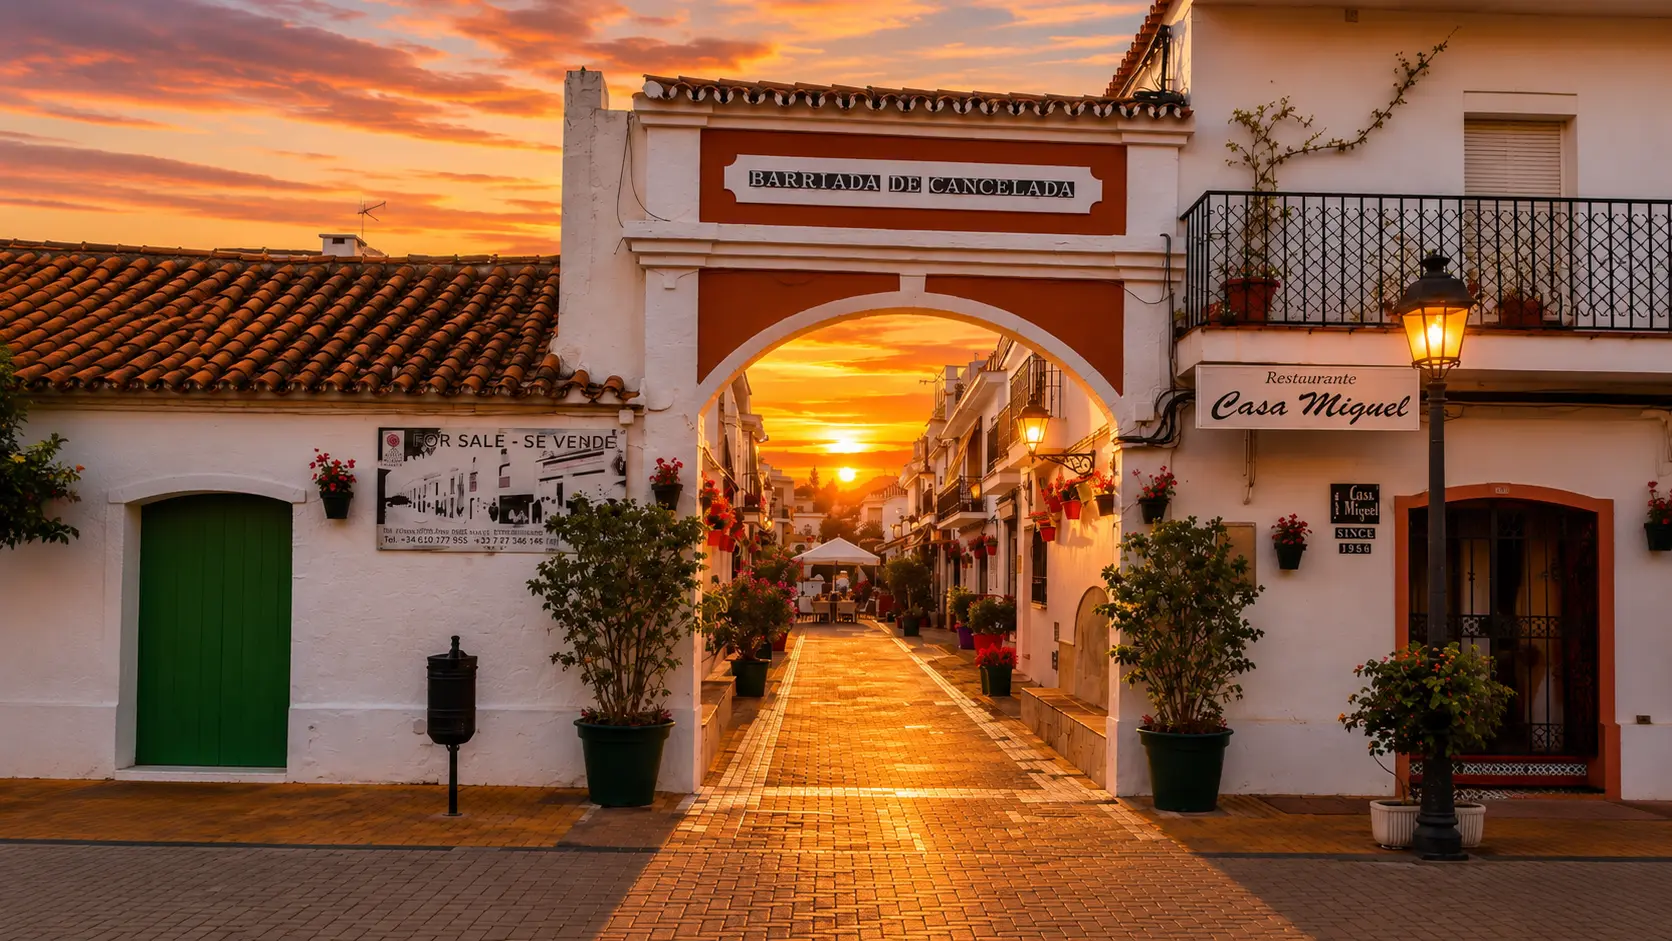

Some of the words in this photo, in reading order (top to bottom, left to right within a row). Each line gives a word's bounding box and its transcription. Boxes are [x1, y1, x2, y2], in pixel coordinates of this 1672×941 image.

[751, 171, 879, 190] BARRIADA
[890, 176, 921, 192] DE
[929, 177, 1074, 197] CANCELADA
[1265, 371, 1357, 385] Restaurante
[1211, 391, 1289, 420] Casa
[1298, 391, 1411, 425] Miguel
[413, 433, 451, 448] FOR
[458, 434, 505, 448] SALE
[524, 435, 546, 448] SE
[553, 435, 618, 449] VENDE
[1337, 529, 1374, 538] SINCE
[1342, 544, 1370, 553] 1956
